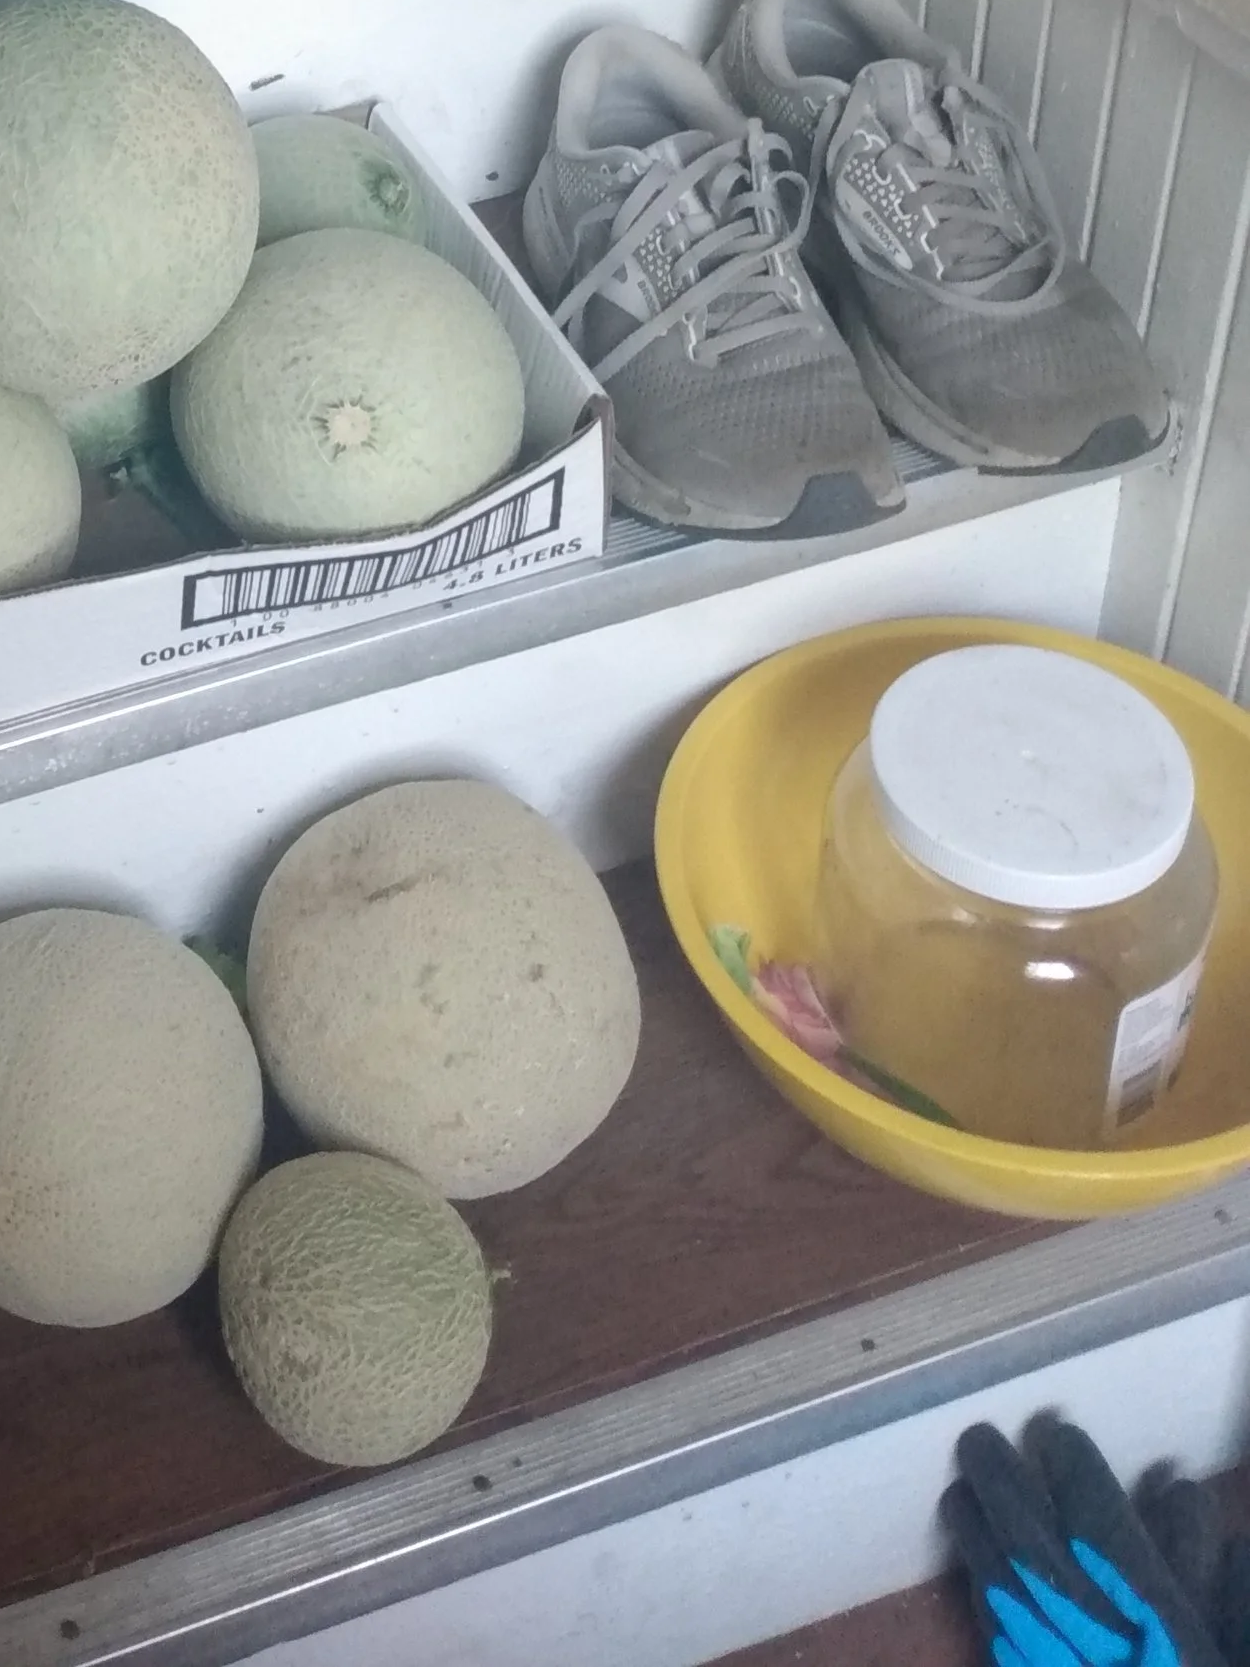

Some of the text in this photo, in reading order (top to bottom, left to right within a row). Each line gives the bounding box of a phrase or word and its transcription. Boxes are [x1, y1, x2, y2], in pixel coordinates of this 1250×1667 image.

[861, 210, 901, 255] BROOKS
[442, 537, 583, 591] 4.8 LITERS
[140, 621, 286, 667] COCKTAILS
